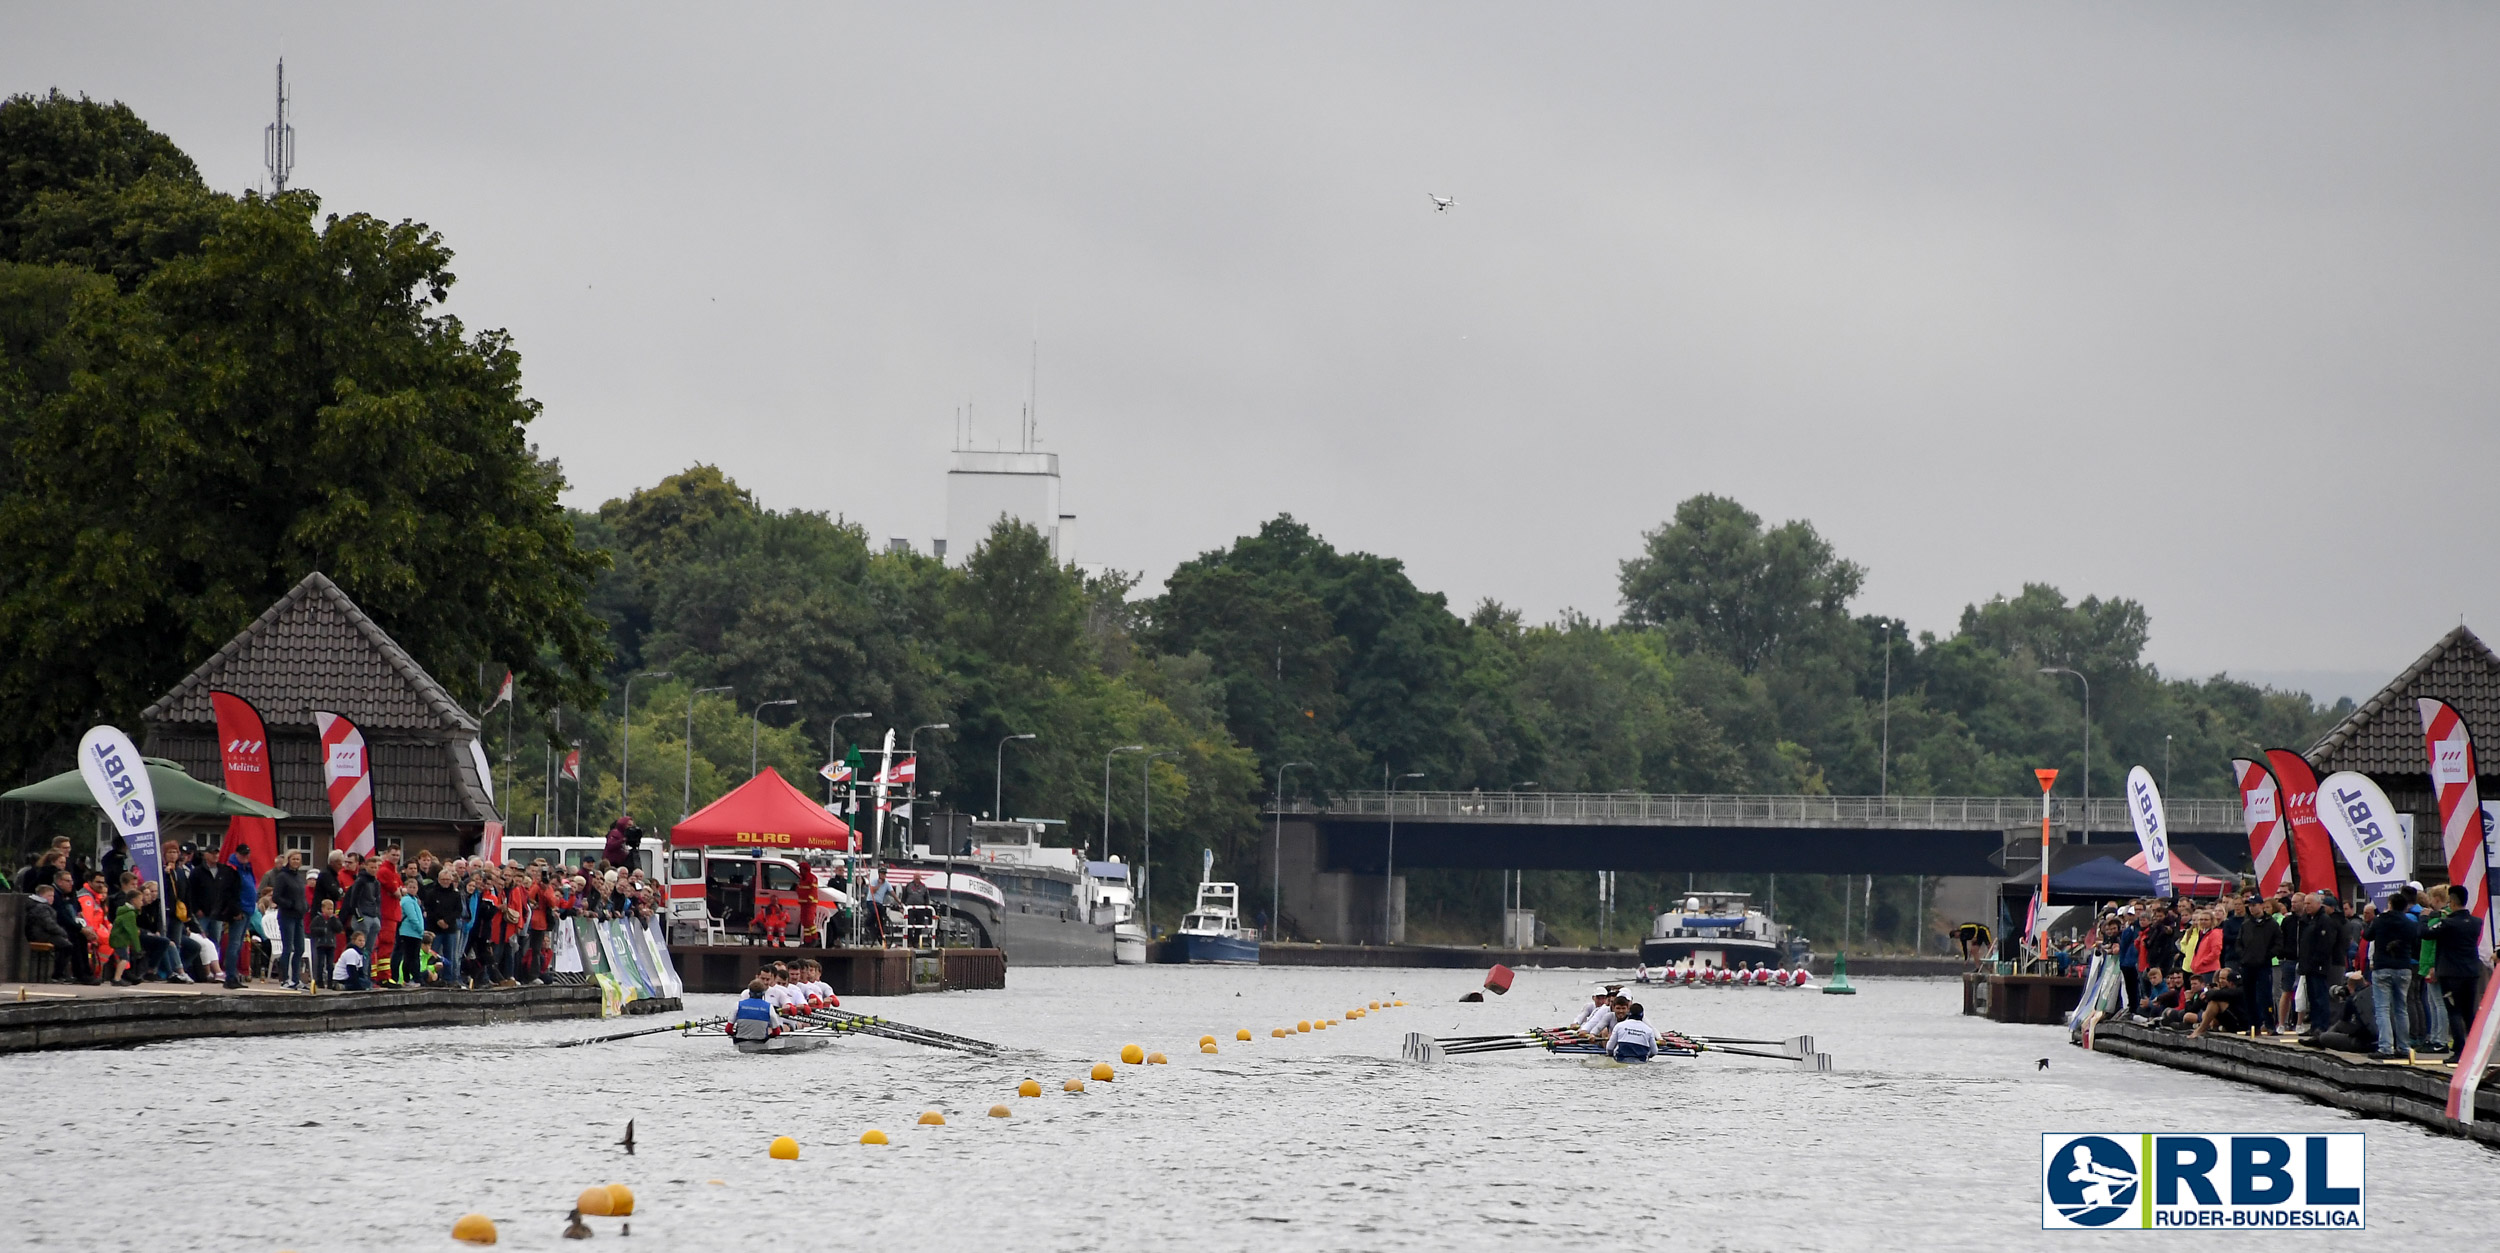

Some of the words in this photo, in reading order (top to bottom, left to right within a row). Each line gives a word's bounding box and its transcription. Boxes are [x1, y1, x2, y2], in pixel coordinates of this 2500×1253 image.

[228, 762, 260, 773] Melitta
[2292, 816, 2317, 827] Melitta
[736, 832, 791, 844] DLRG
[808, 837, 837, 846] Minden
